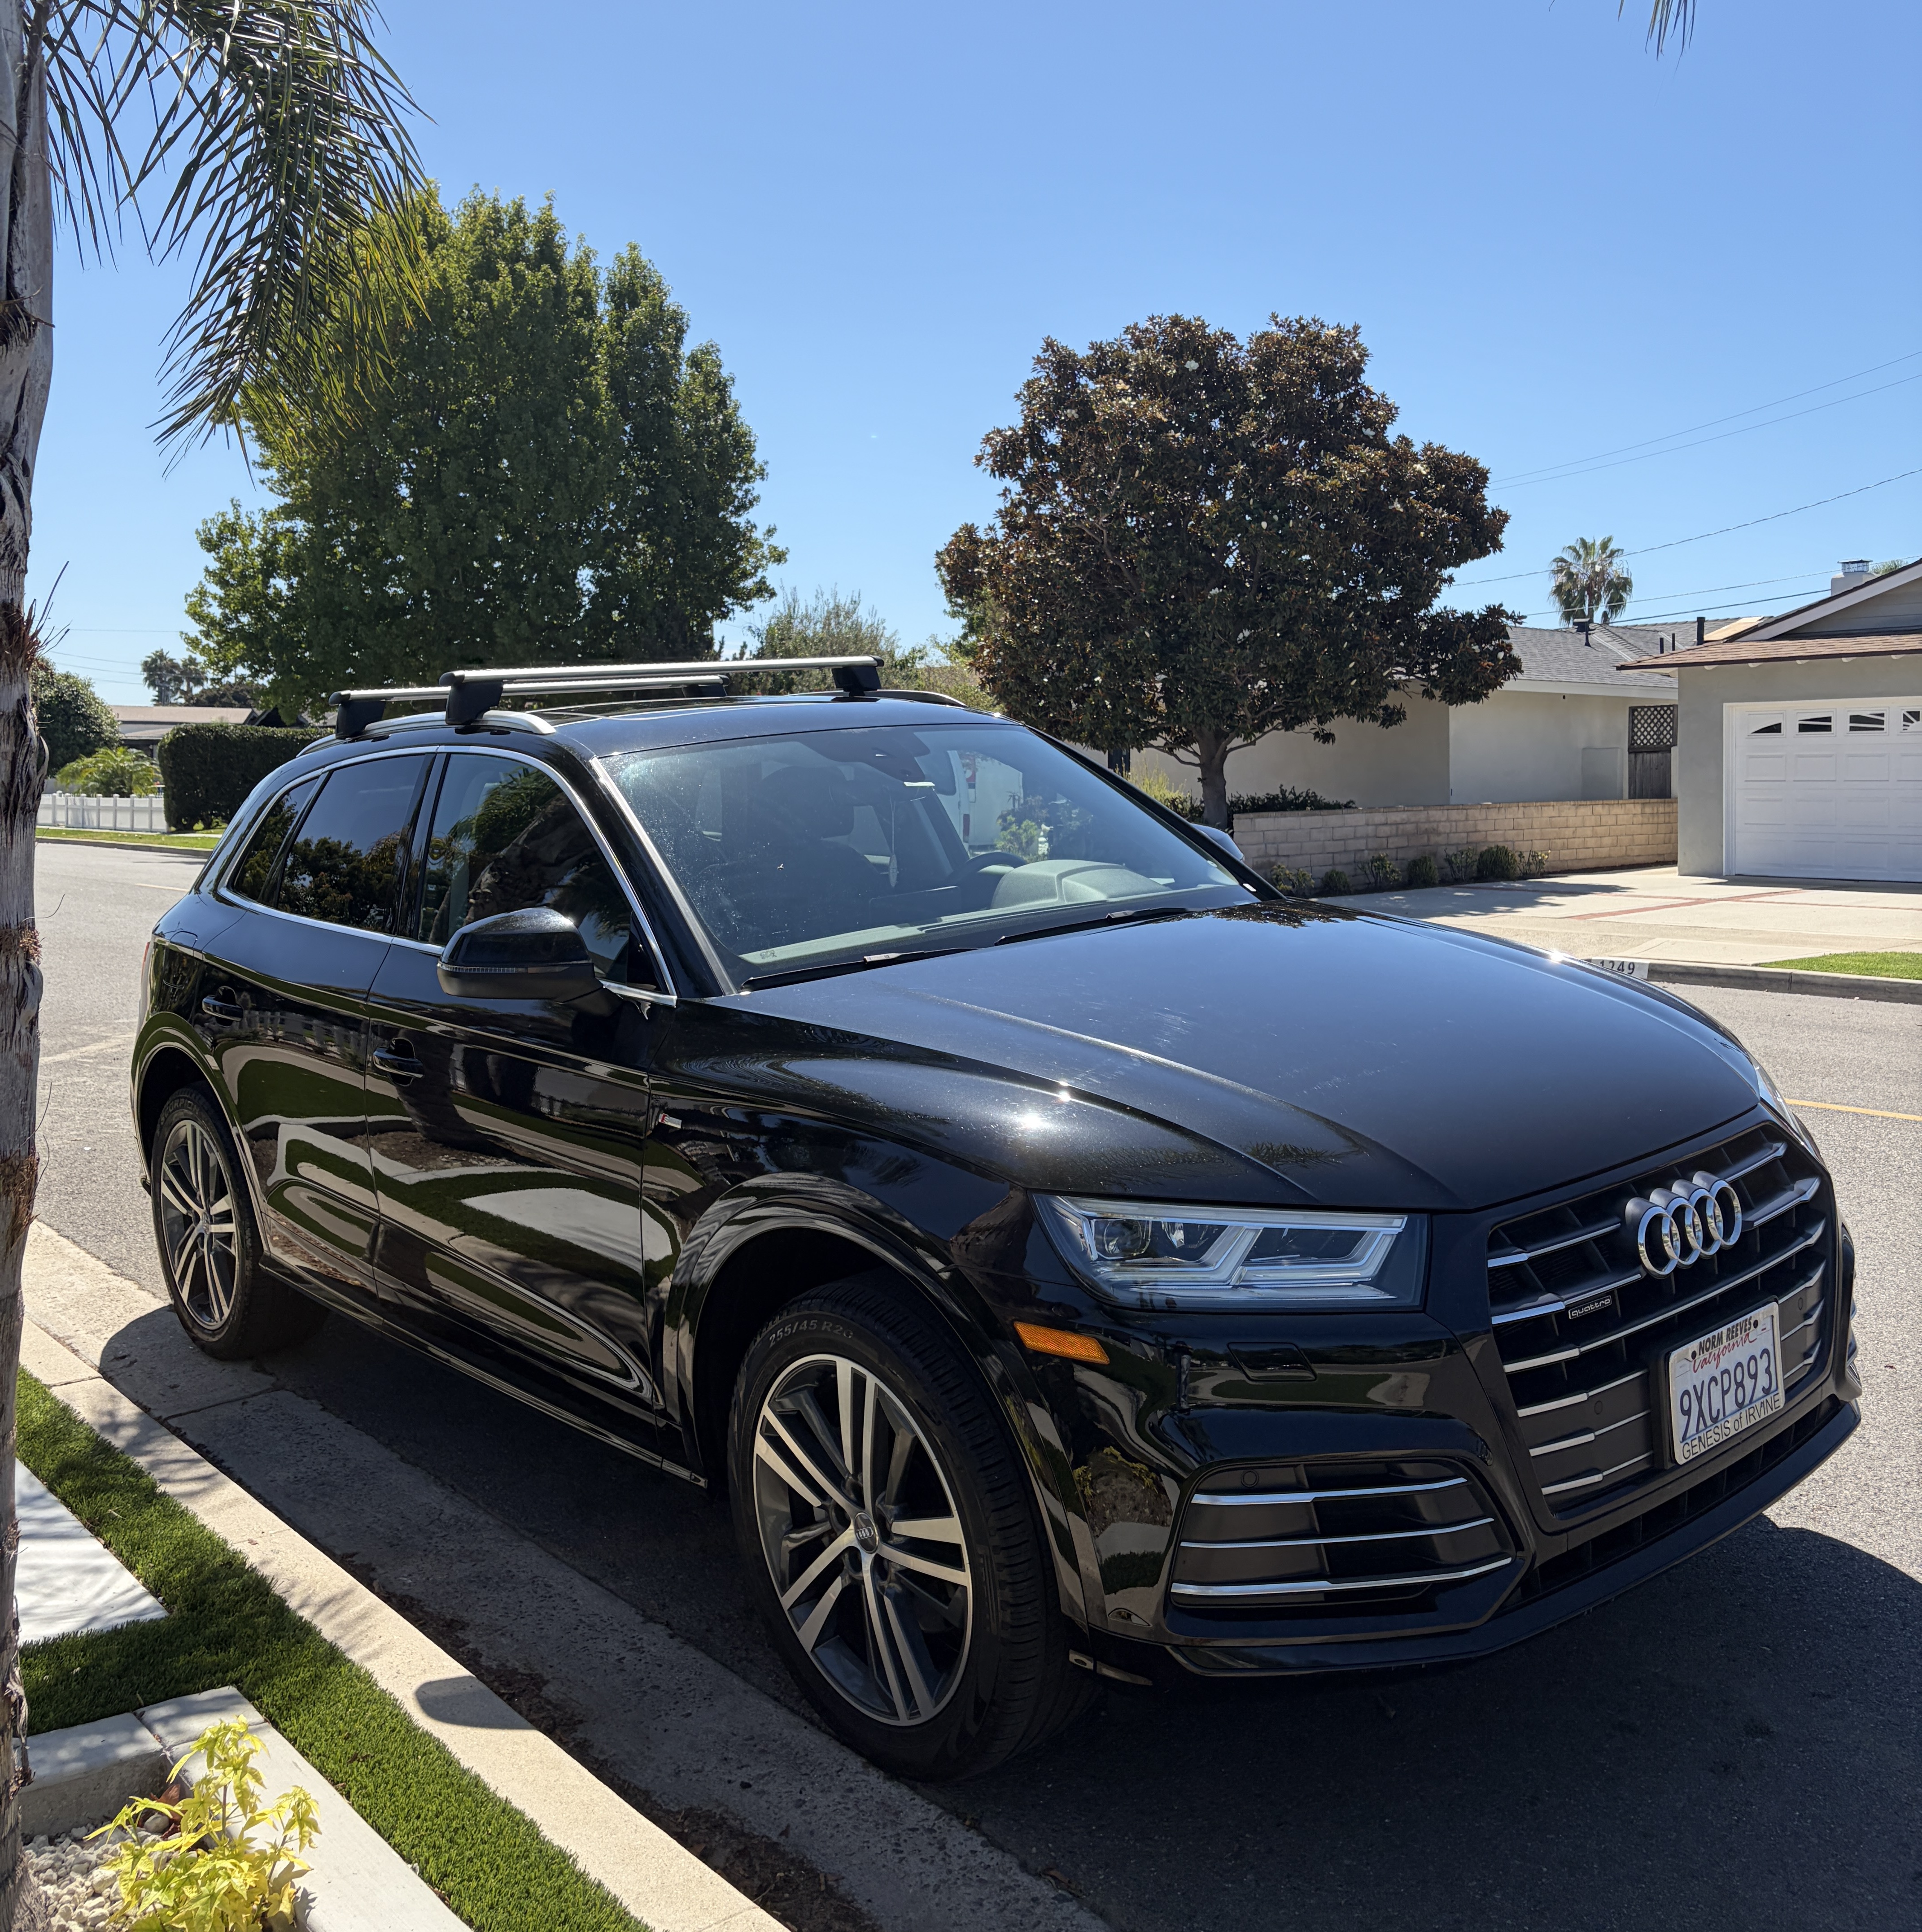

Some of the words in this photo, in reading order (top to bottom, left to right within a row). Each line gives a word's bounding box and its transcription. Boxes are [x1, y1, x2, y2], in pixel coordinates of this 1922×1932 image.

[1571, 1298, 1610, 1317] quattro
[769, 1320, 818, 1348] 255/45
[1699, 1330, 1723, 1356] NORM
[1726, 1316, 1752, 1343] REEVES
[1680, 1348, 1772, 1442] 9XCP893
[1682, 1420, 1731, 1460] GENESIS
[1733, 1412, 1743, 1430] of
[1745, 1392, 1781, 1426] IRVINE
